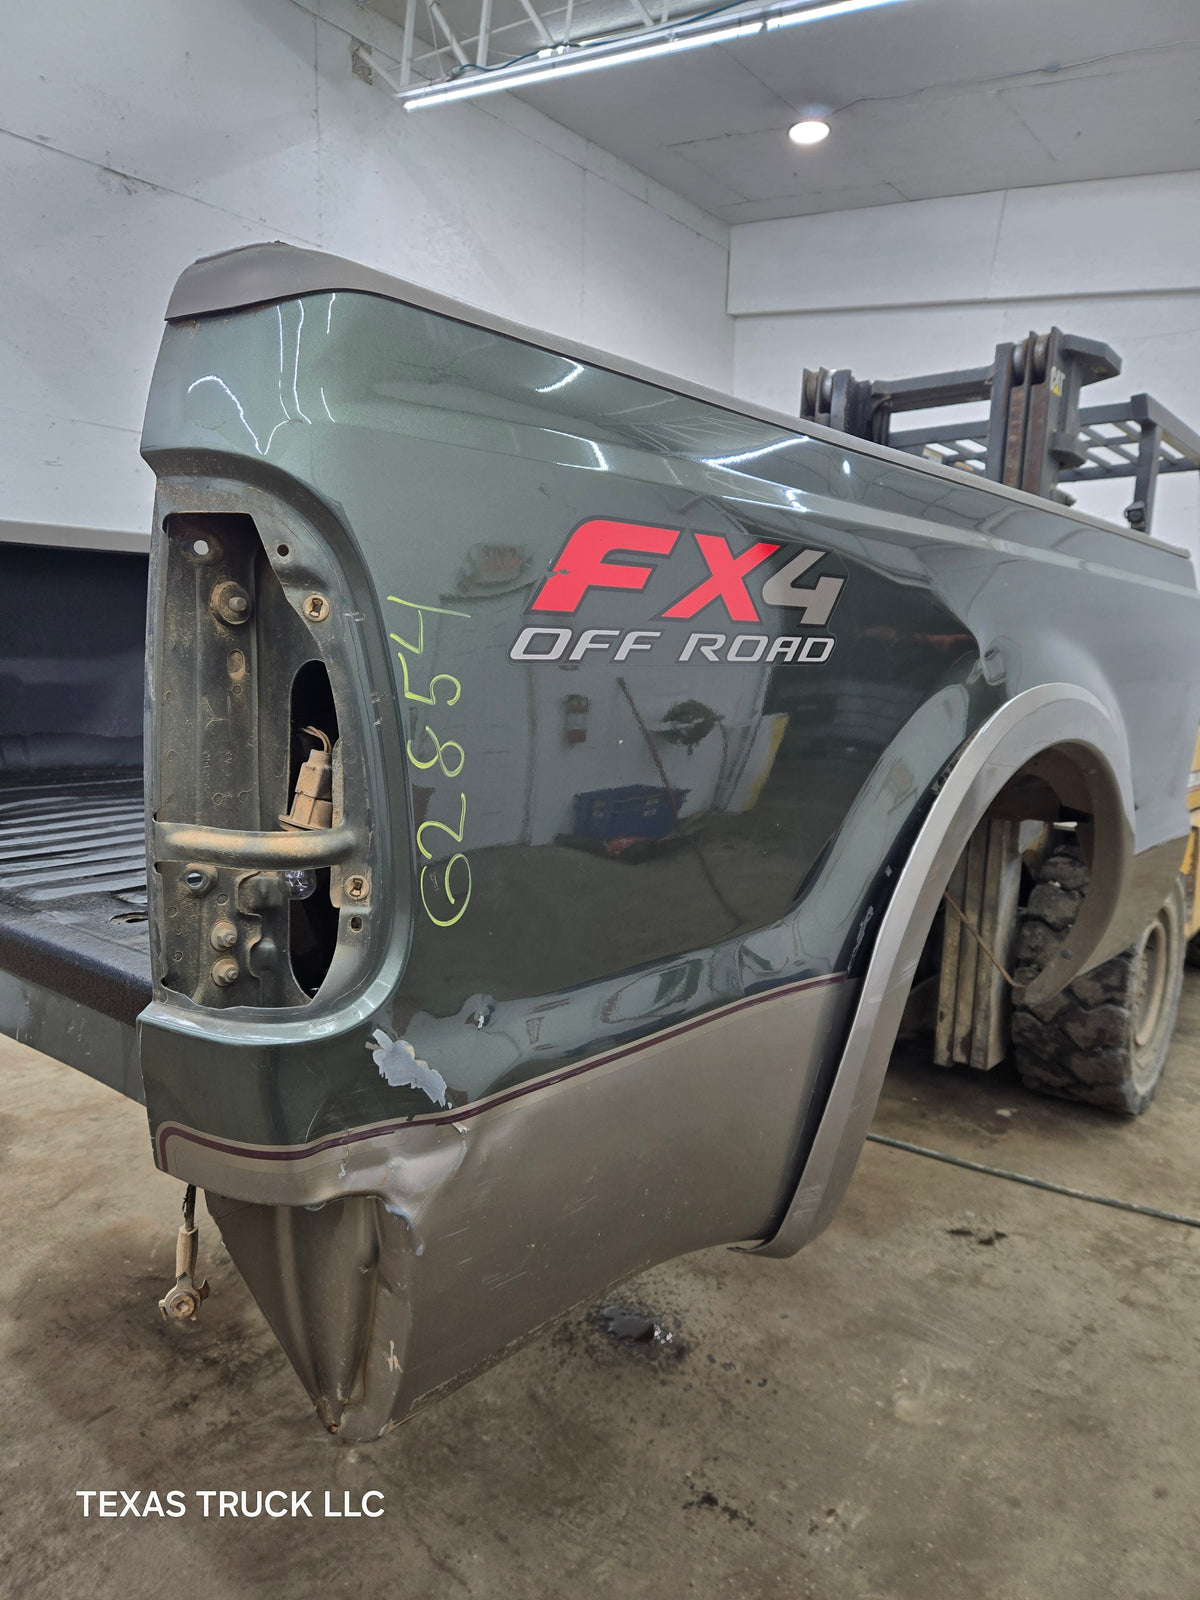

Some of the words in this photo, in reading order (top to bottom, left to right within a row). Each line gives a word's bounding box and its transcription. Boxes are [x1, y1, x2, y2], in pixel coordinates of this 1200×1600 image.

[1050, 366, 1066, 397] CAT
[530, 519, 846, 625] FX4
[509, 627, 662, 661] OFF
[678, 632, 835, 662] ROAD
[386, 595, 472, 927] 62854
